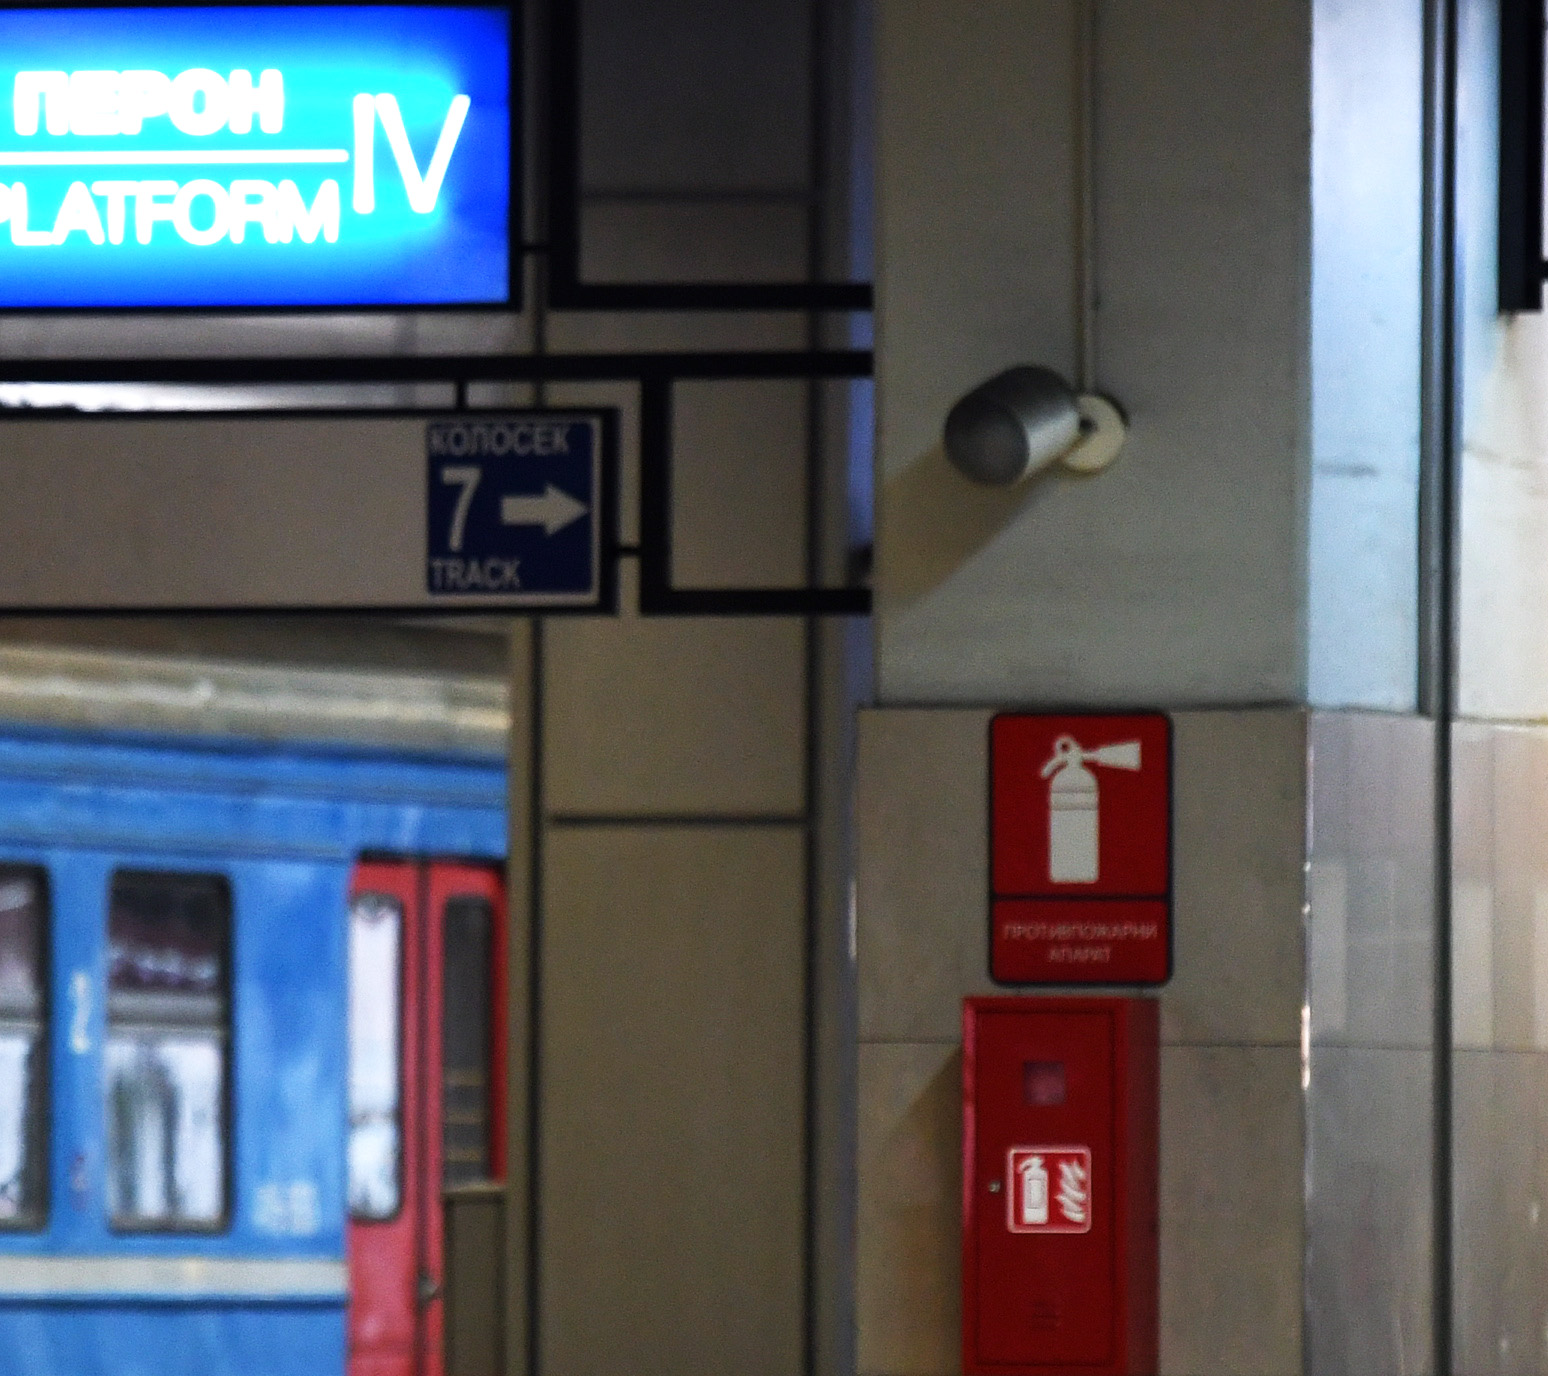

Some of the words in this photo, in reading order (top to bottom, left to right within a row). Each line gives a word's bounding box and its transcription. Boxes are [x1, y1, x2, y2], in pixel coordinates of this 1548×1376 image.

[13, 67, 284, 136] ПЕРОН
[352, 91, 471, 215] IV
[442, 466, 482, 552] 7
[431, 557, 522, 589] TRACK
